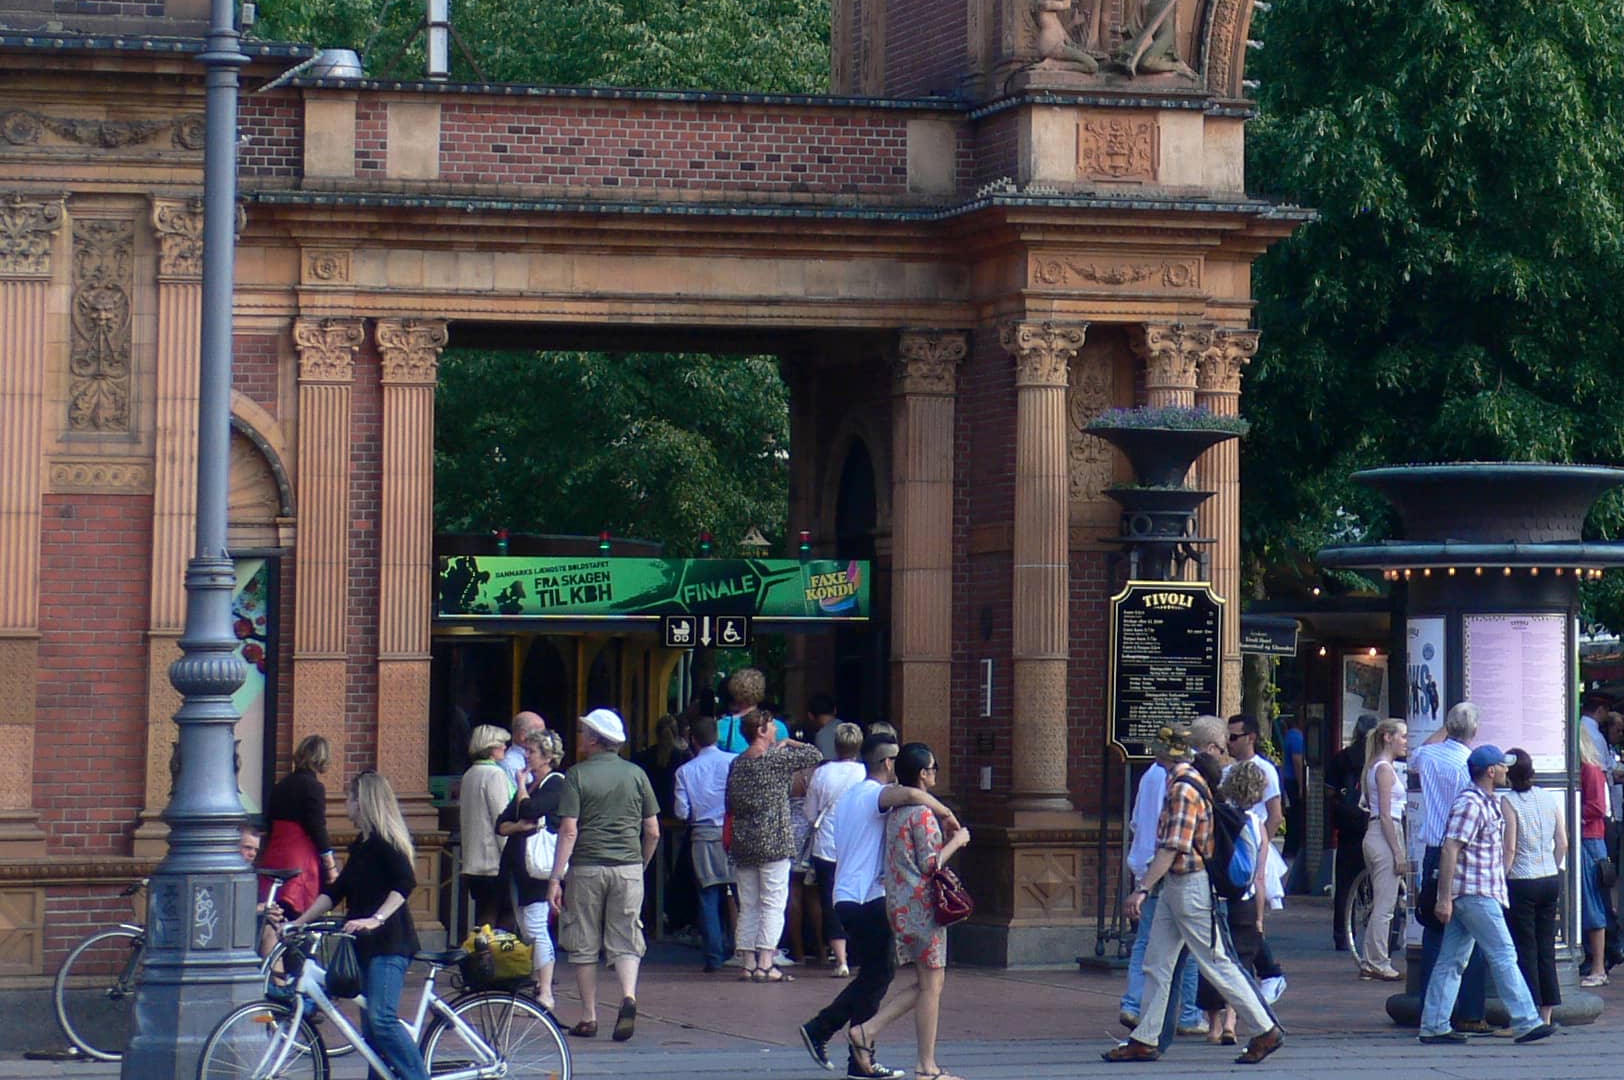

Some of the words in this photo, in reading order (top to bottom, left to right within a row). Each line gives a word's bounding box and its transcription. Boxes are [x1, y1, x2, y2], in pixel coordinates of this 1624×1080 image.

[534, 577, 559, 589] FRA
[561, 571, 611, 586] SKAGEN
[810, 571, 848, 588] FAXE
[536, 588, 568, 608] TIL
[570, 583, 612, 604] KBH
[684, 574, 756, 604] FINALE
[805, 582, 855, 601] KONDI
[1142, 592, 1195, 608] TIVOLI
